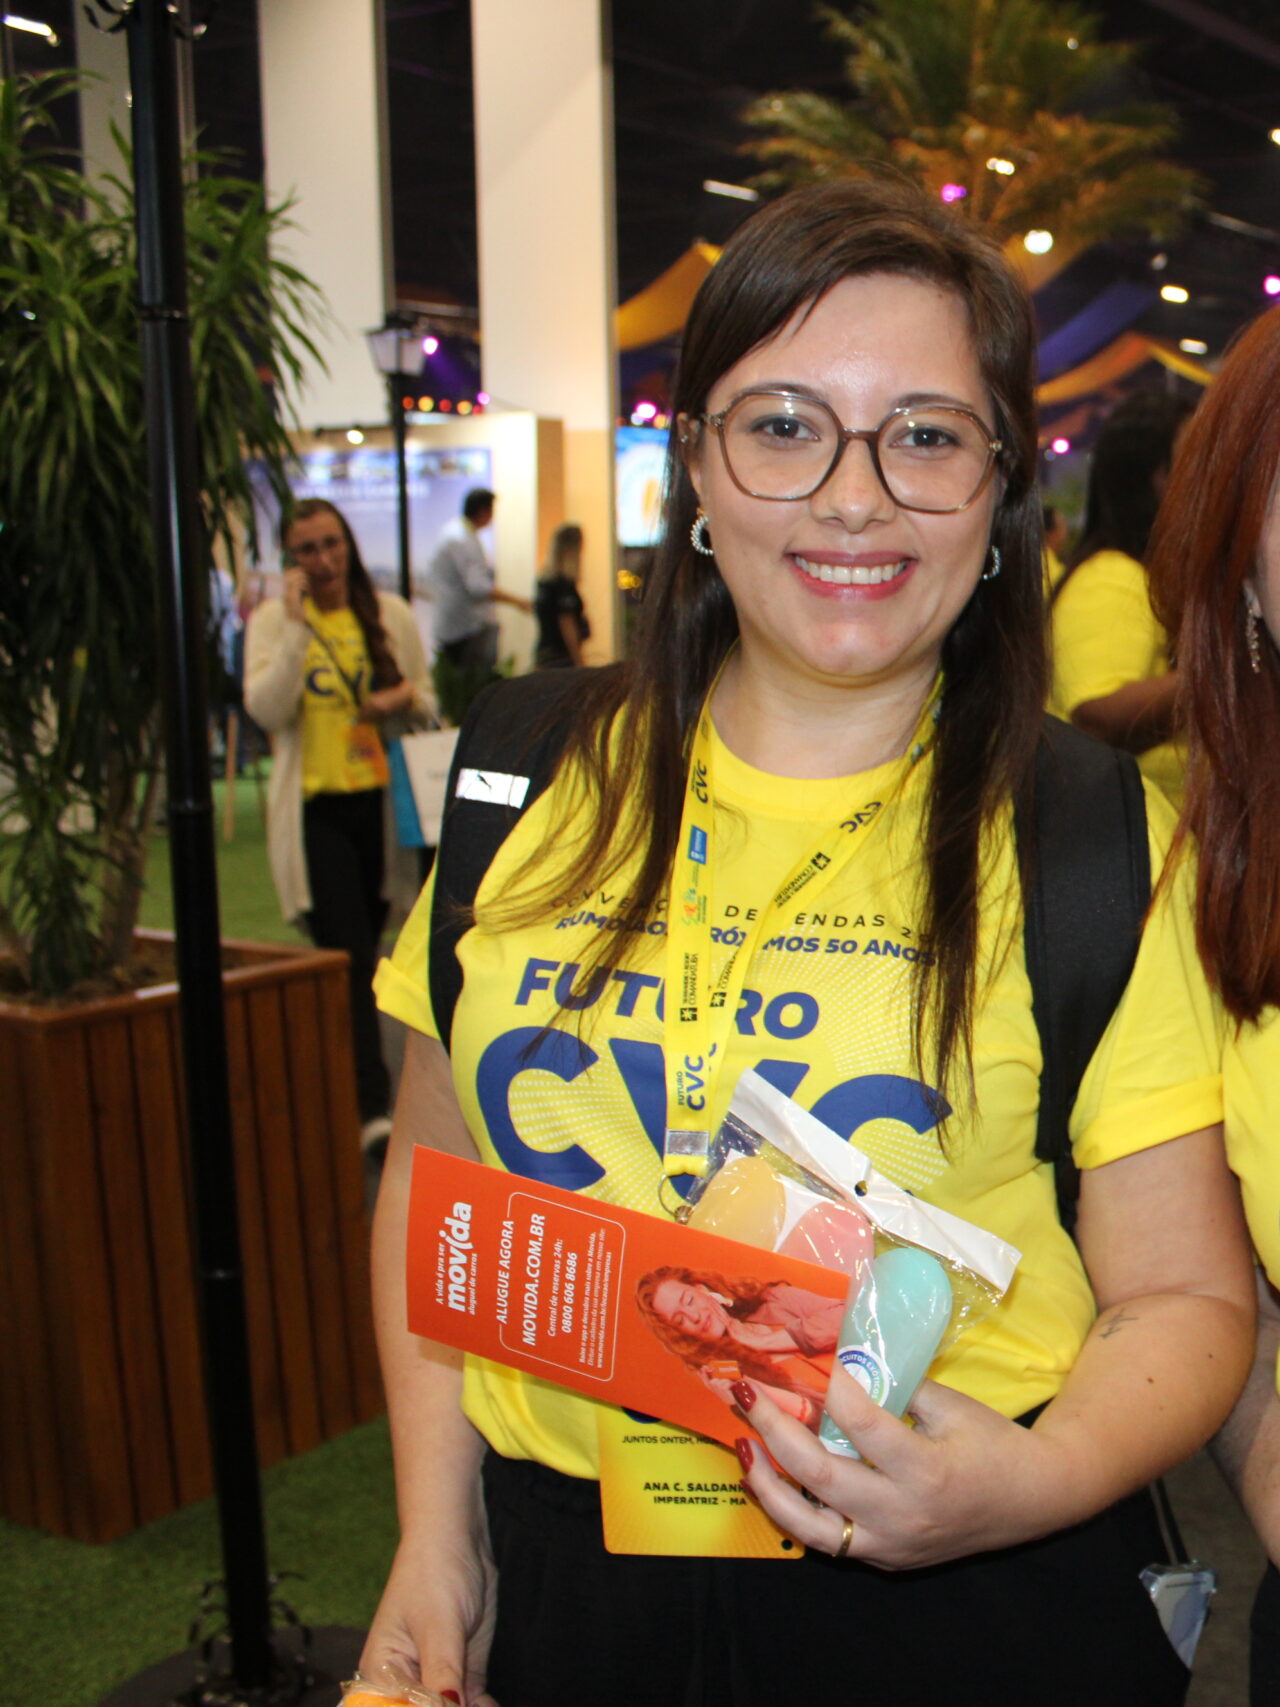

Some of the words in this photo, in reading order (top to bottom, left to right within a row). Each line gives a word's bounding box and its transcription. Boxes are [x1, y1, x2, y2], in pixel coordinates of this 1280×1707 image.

[694, 759, 709, 804] CVC
[724, 905, 758, 921] DE
[795, 913, 886, 928] ENDAS
[626, 919, 668, 936] AO
[710, 926, 820, 953] RÓMOS
[825, 938, 858, 954] 50
[862, 939, 937, 967] ANOS
[514, 957, 820, 1041] FUTRO
[677, 1071, 685, 1106] FUTURO
[684, 1055, 706, 1111] CVC
[439, 1202, 474, 1313] movida
[502, 1220, 515, 1269] AGORA
[553, 1238, 563, 1258] 24h:
[437, 1257, 446, 1272] pra
[470, 1253, 478, 1276] carros
[522, 1213, 546, 1345] MOVIDA.COM.BR
[551, 1259, 561, 1294] reservas
[565, 1252, 578, 1281] 8686
[435, 1279, 444, 1296] vida
[468, 1277, 477, 1287] de
[496, 1270, 510, 1323] ALUGUE
[563, 1282, 575, 1304] 606
[467, 1287, 477, 1315] aluguel
[549, 1295, 559, 1306] de
[547, 1306, 558, 1336] Central
[561, 1304, 573, 1333] 0800
[622, 1435, 657, 1443] JUNTOS
[643, 1482, 670, 1491] ANA
[687, 1482, 744, 1492] SALDANH
[653, 1496, 719, 1505] IMPERATRIZ
[730, 1497, 747, 1506] MA
